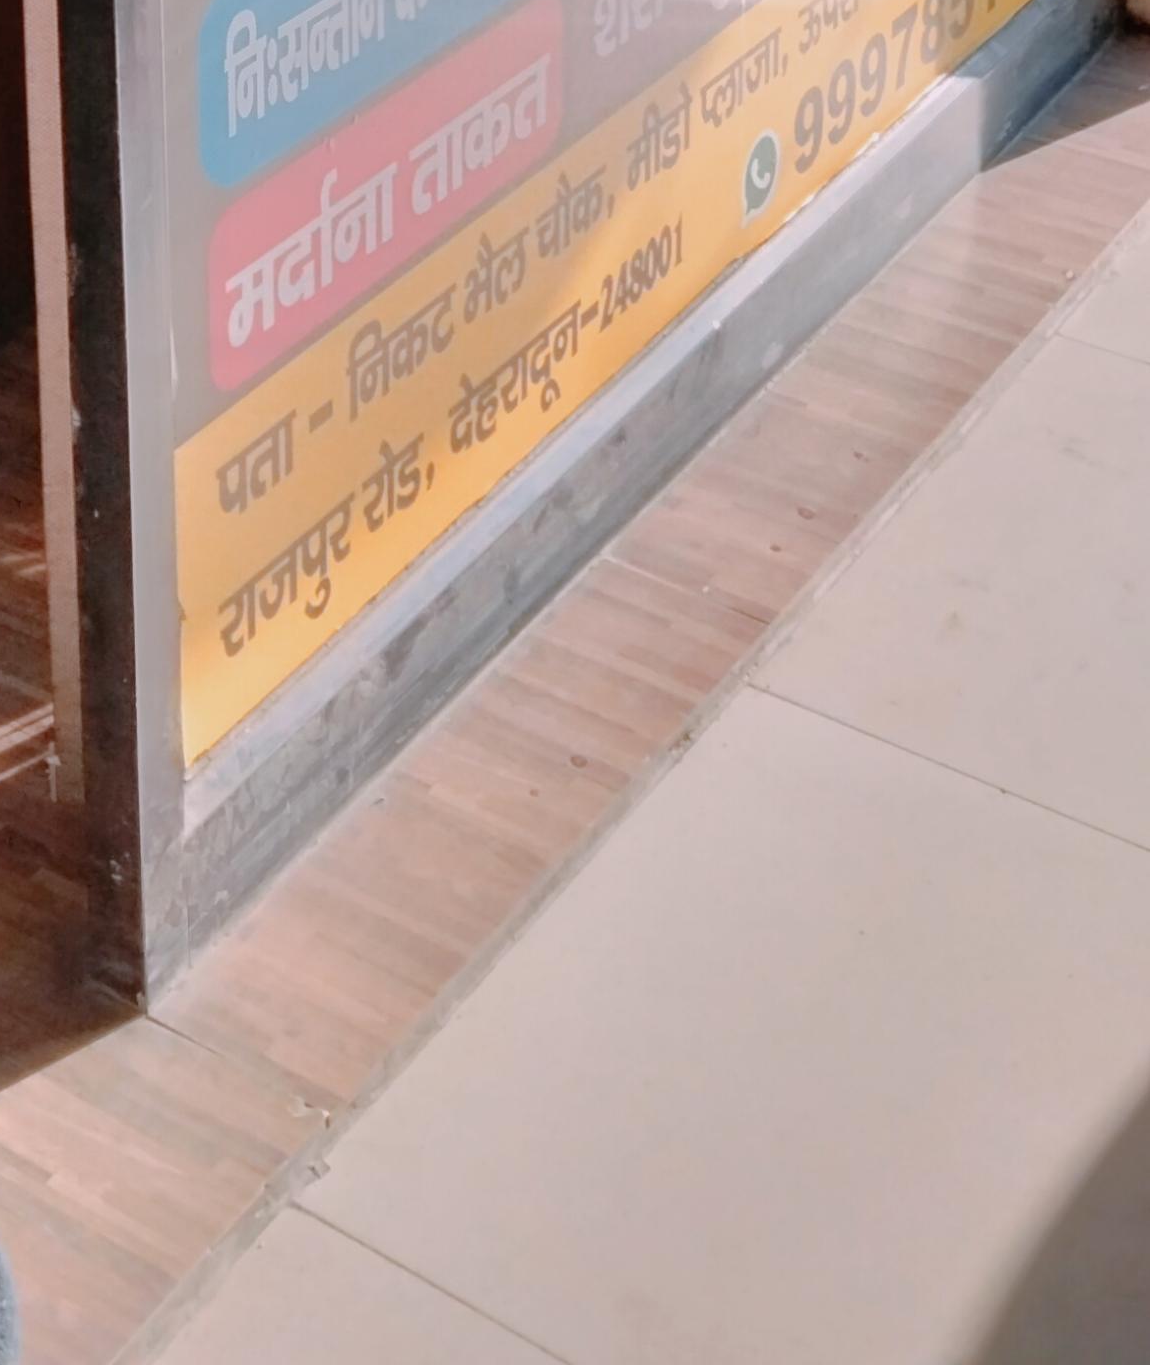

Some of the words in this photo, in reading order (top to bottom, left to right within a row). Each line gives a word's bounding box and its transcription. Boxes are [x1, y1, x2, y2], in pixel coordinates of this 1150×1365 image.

[215, 408, 297, 516] पता
[346, 282, 458, 424] निकट
[625, 80, 693, 192] मीडो
[224, 168, 398, 350] मर्दाना
[408, 52, 552, 216] ताकत
[217, 491, 356, 658] राजपुर
[361, 431, 436, 534] रोड,
